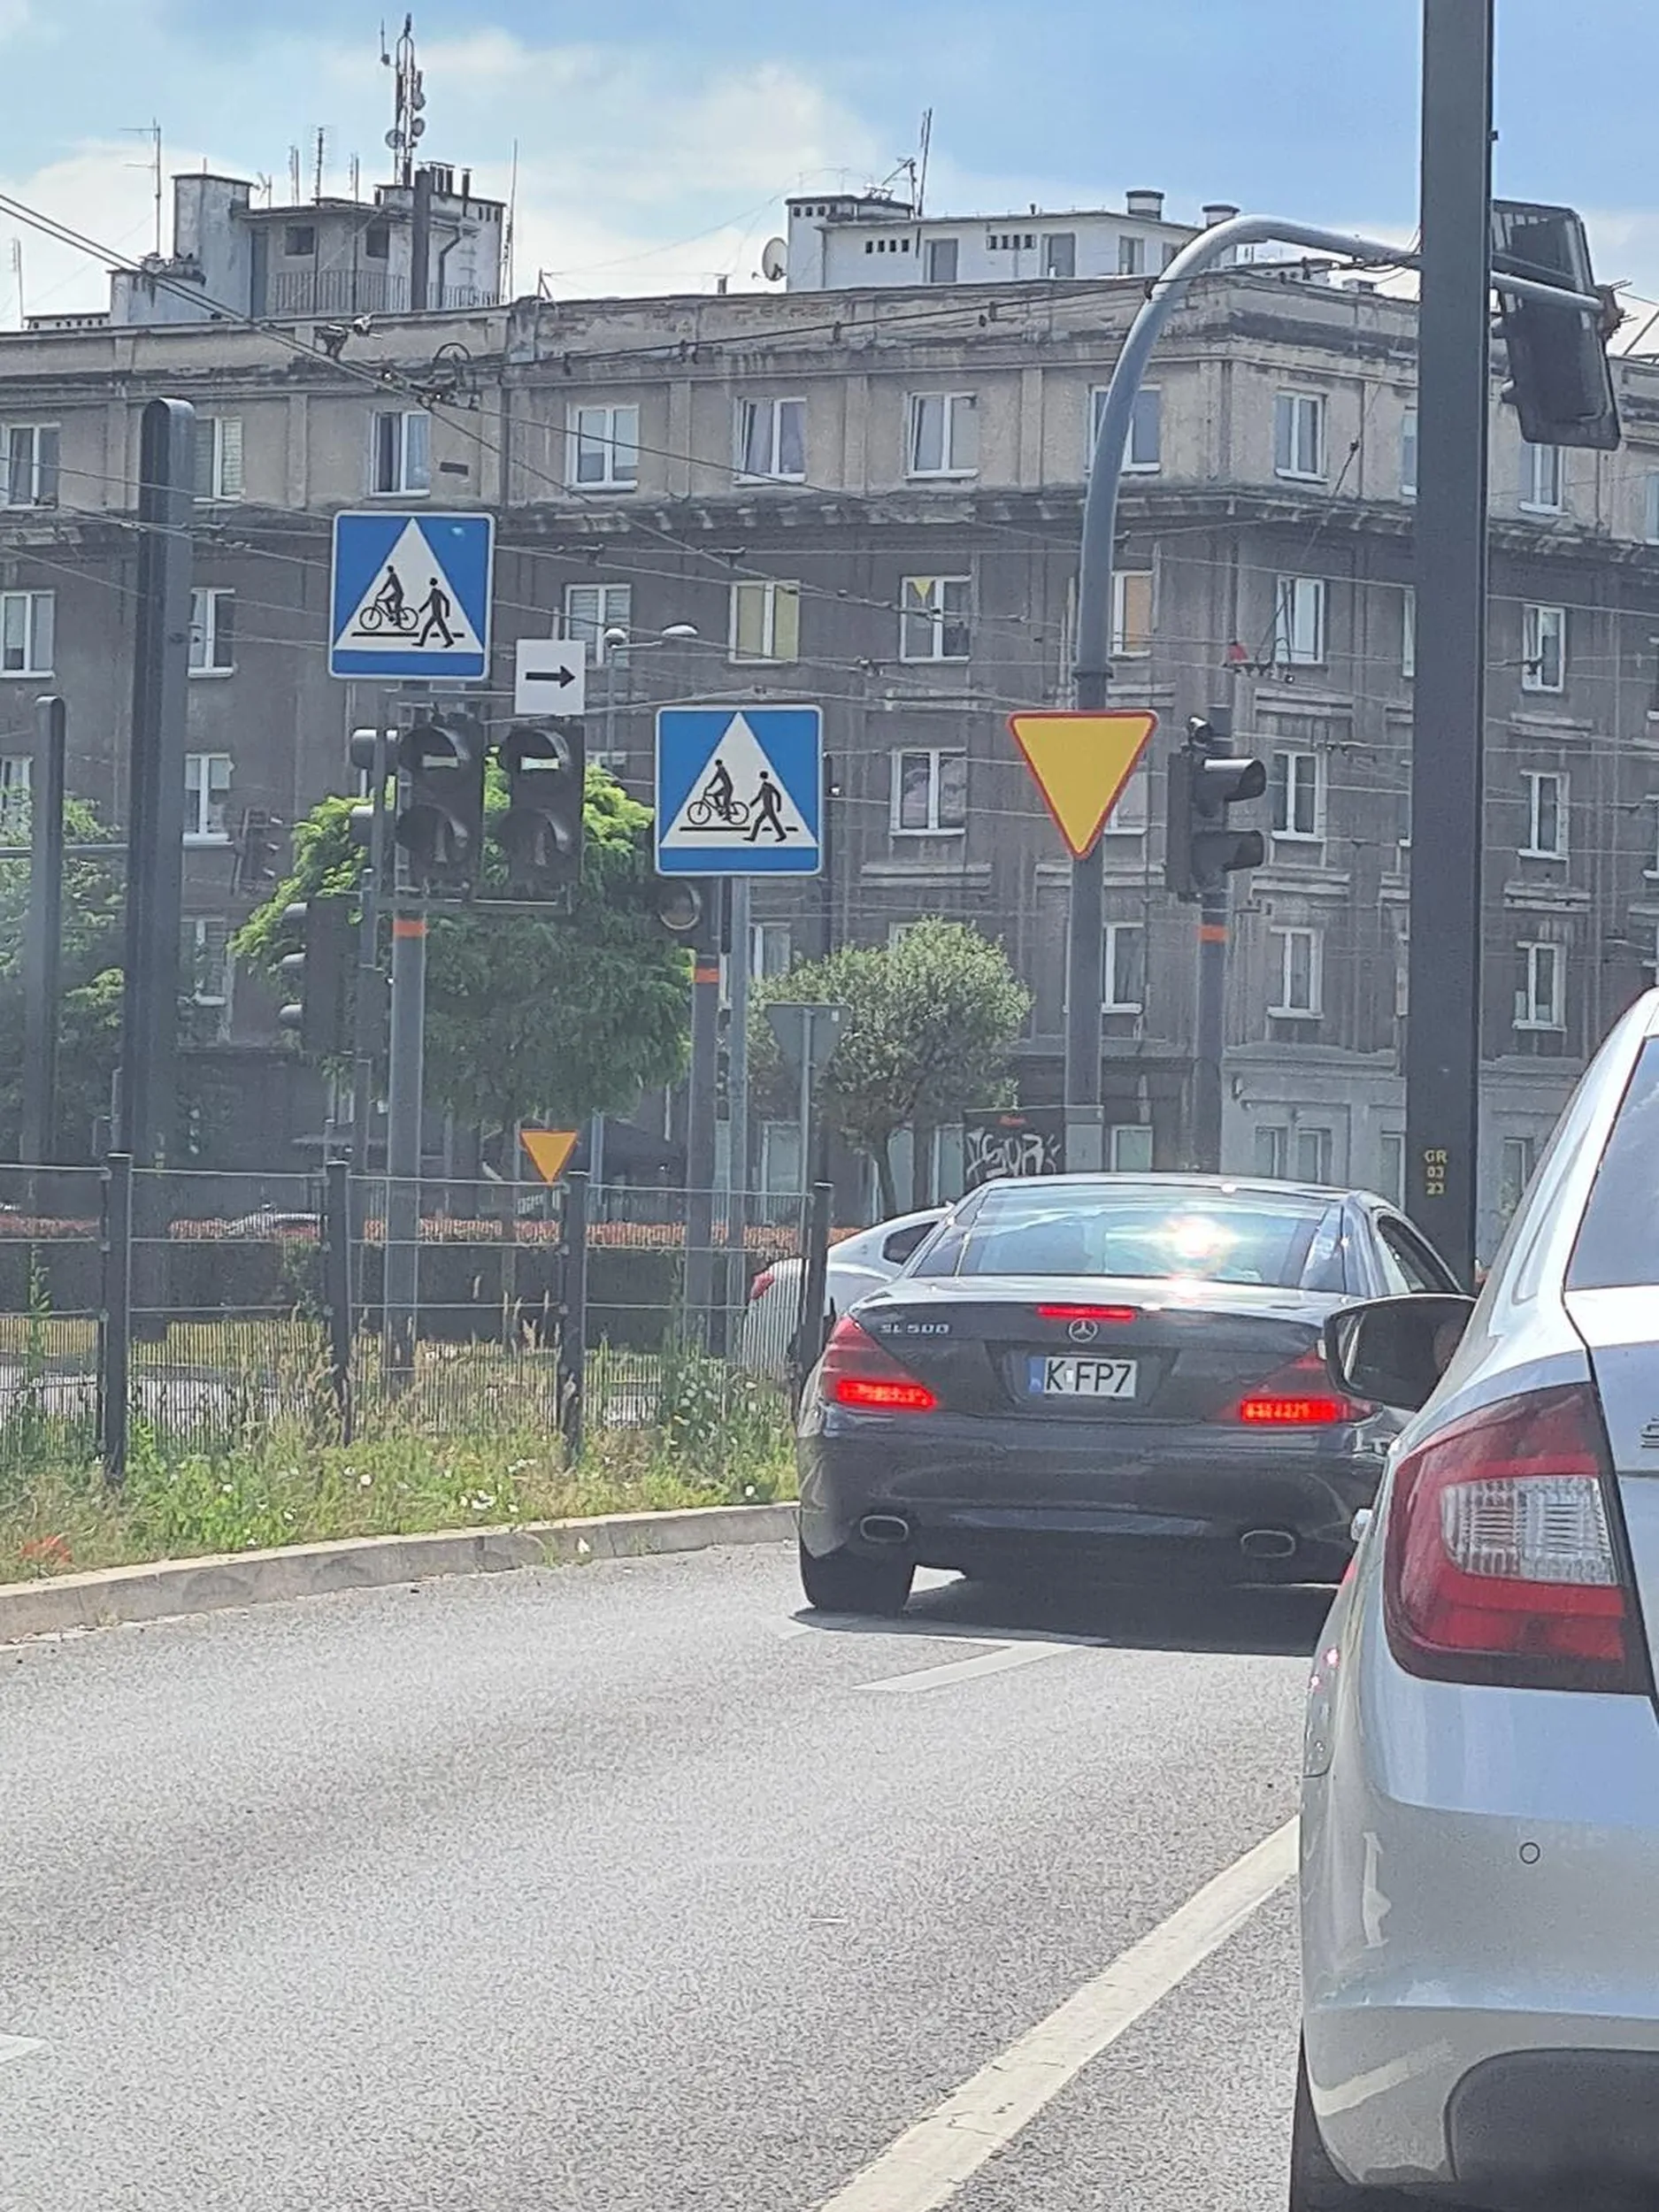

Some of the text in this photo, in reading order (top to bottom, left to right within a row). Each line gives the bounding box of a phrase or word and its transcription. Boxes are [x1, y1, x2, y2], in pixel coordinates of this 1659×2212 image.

[1425, 1149, 1448, 1164] GR
[1426, 1165, 1444, 1179] 03
[880, 1323, 950, 1334] SL 500
